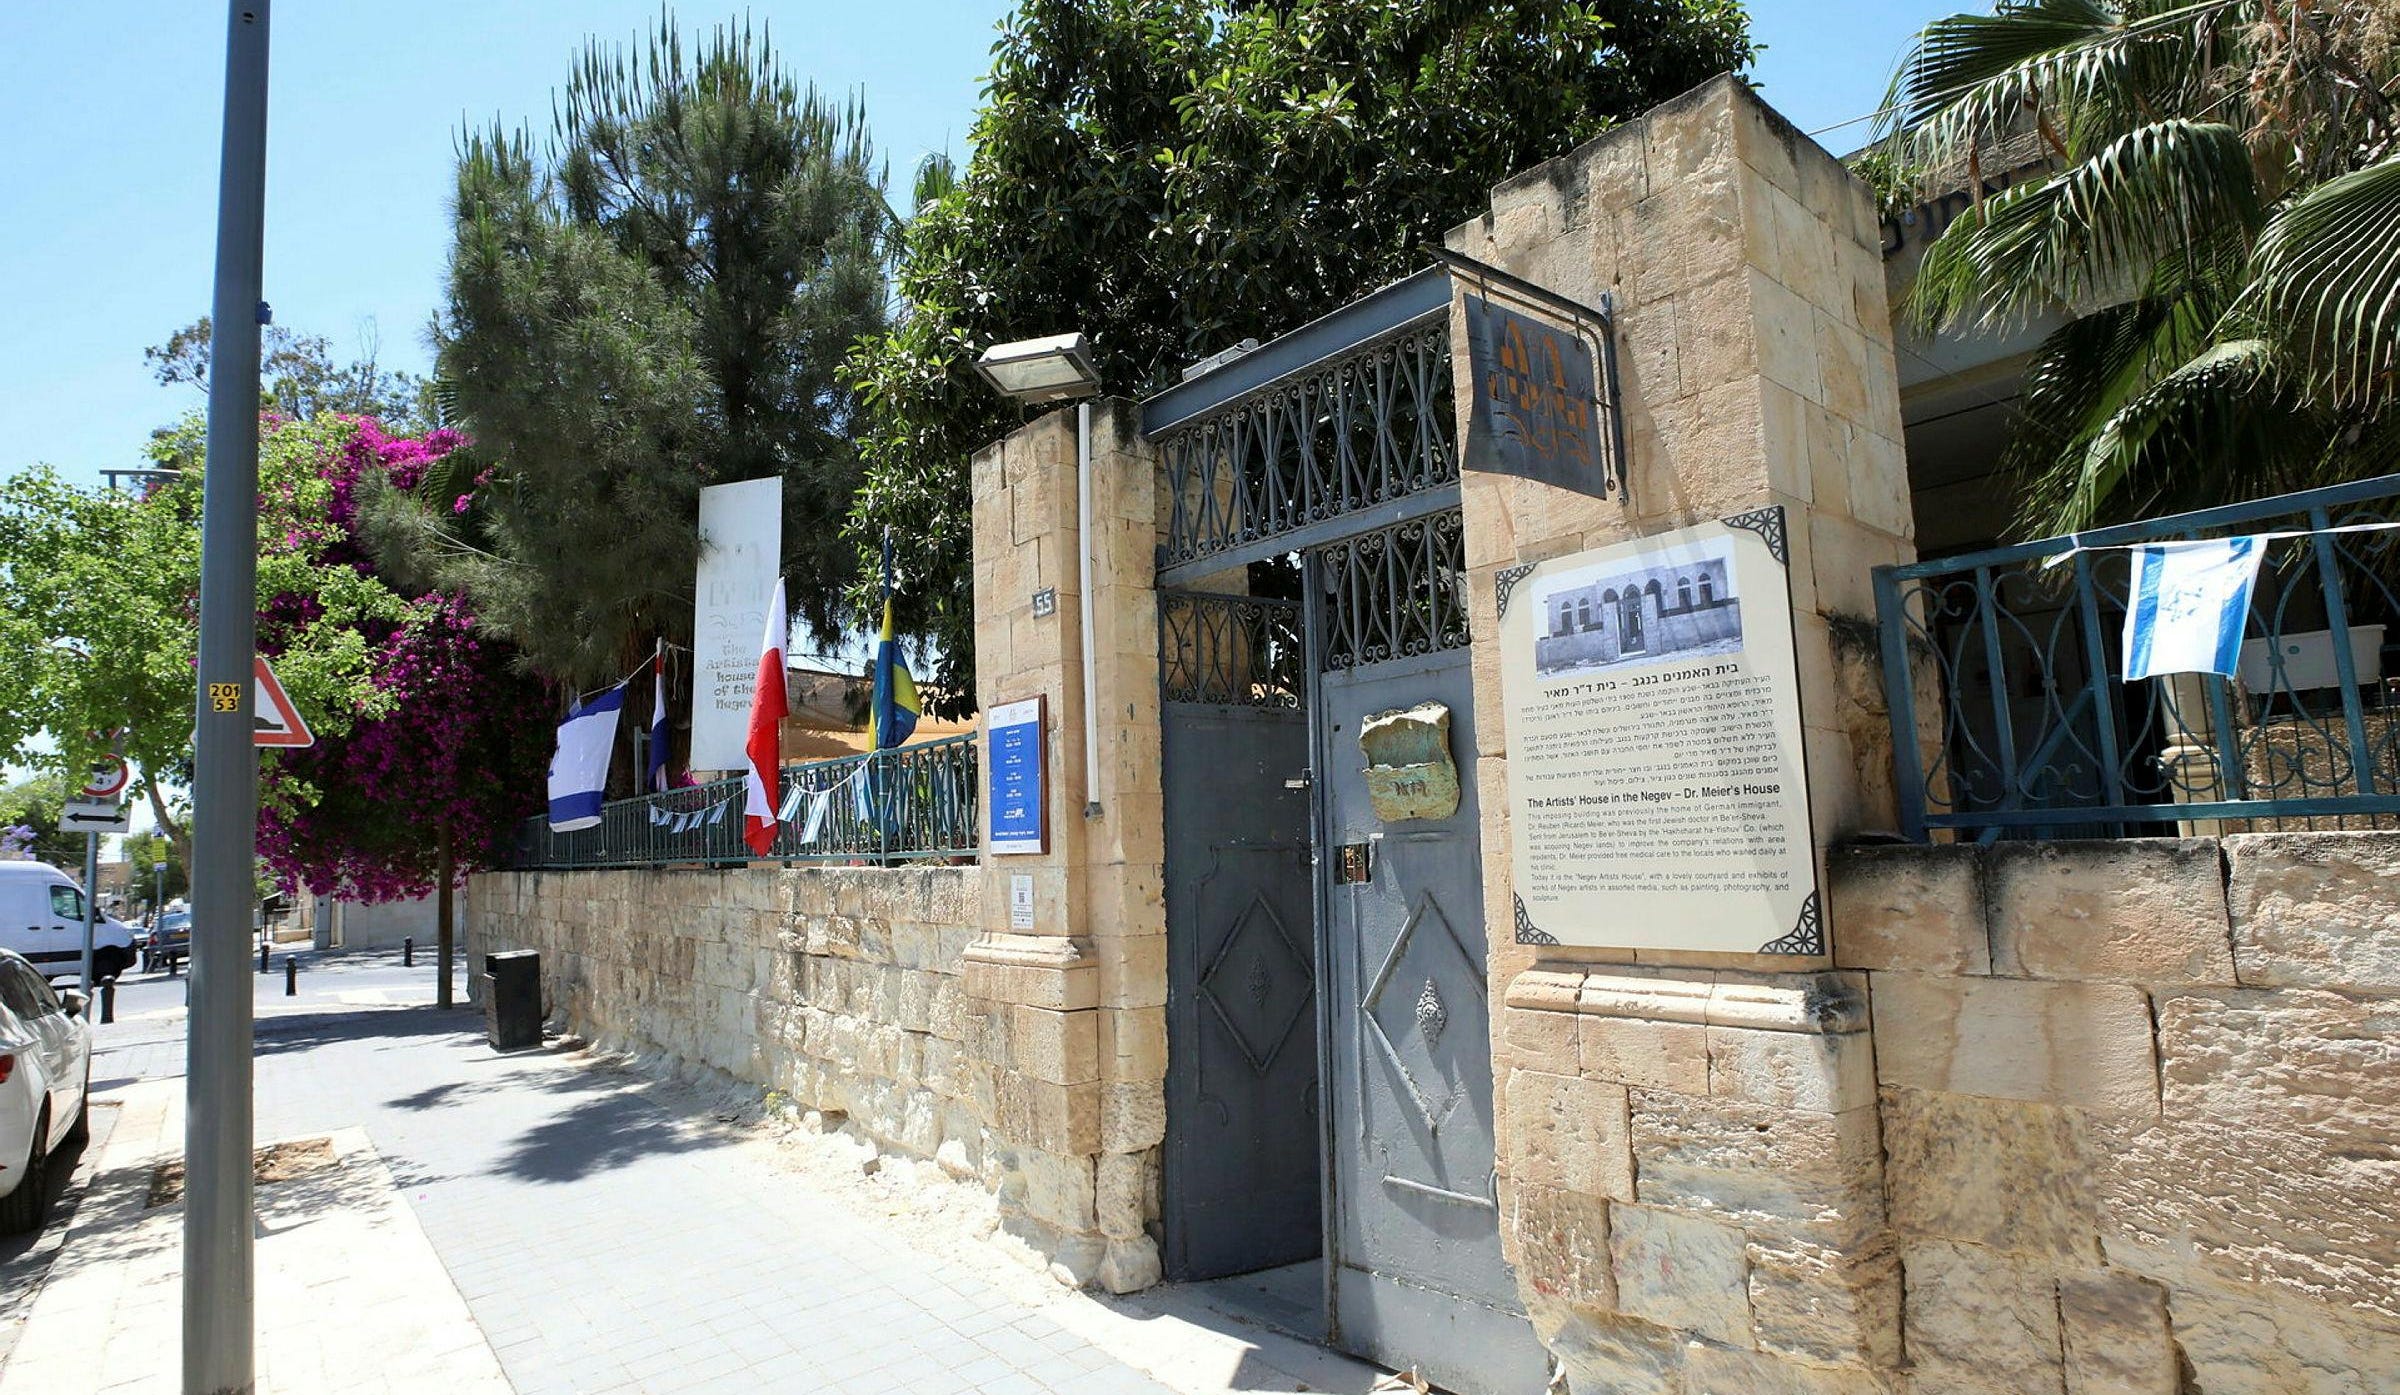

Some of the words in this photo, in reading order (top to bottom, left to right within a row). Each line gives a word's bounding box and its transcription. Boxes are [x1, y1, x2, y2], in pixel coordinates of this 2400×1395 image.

[1036, 593, 1052, 614] 55
[1662, 667, 1710, 682] האמנים
[1714, 663, 1739, 675] בית
[1595, 680, 1616, 692] בית
[1631, 674, 1659, 687] בנגב
[211, 685, 240, 697] 201
[713, 684, 729, 696] of
[1543, 687, 1571, 698] מאיר
[1572, 683, 1592, 695] ד"ר
[215, 698, 236, 711] 53
[1527, 797, 1544, 808] The
[1545, 795, 1576, 807] Artists'
[1578, 794, 1609, 805] House
[1610, 792, 1620, 803] in
[1622, 792, 1639, 803] the
[1640, 790, 1672, 802] Negev
[1683, 787, 1699, 799] Dr.
[1701, 785, 1740, 797] Meier's
[1742, 783, 1780, 795] House
